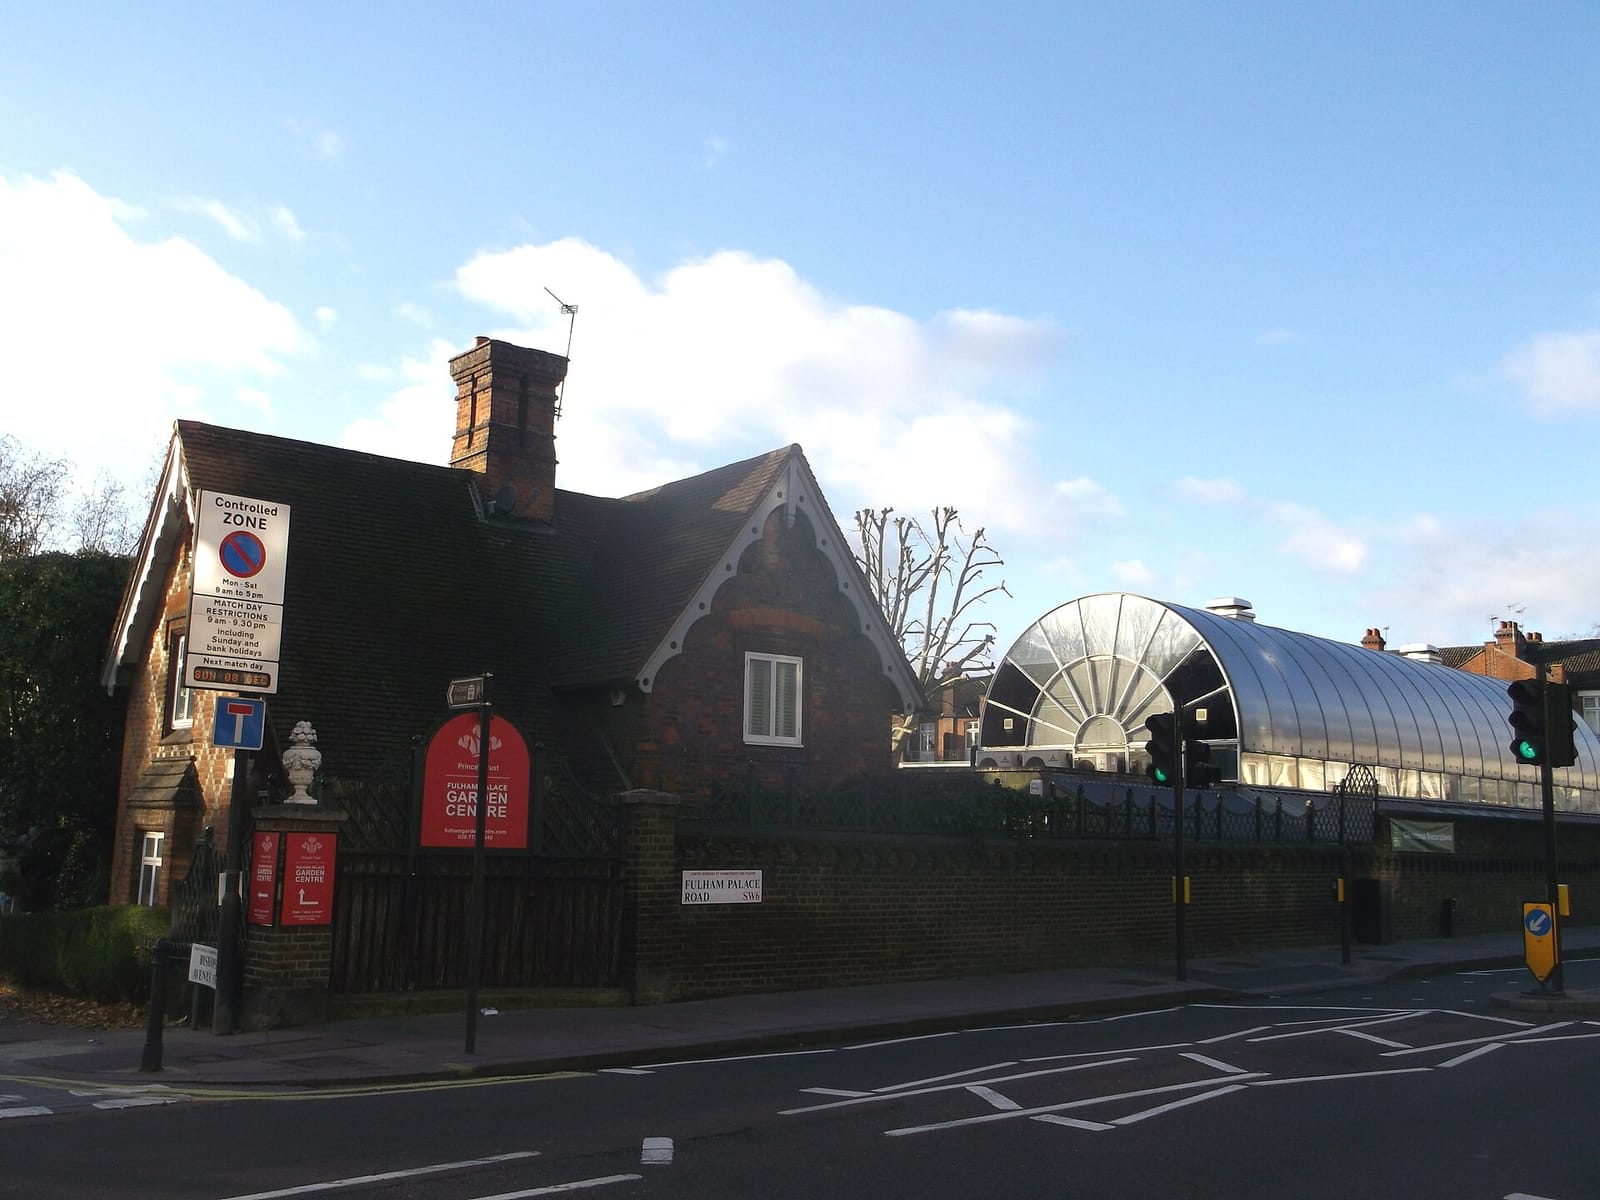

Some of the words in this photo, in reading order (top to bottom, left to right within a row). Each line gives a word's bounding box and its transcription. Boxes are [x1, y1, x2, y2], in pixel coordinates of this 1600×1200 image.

[215, 497, 278, 516] Controlled
[223, 512, 267, 530] ZONE
[235, 588, 243, 596] to
[214, 600, 243, 609] MATCH
[246, 603, 263, 611] DAY
[206, 607, 268, 621] RESTRICTIONS
[211, 636, 242, 646] Sunday
[244, 640, 259, 648] and
[206, 644, 227, 652] bank
[229, 646, 262, 657] holidays
[203, 657, 222, 665] Next
[224, 659, 248, 668] match
[250, 662, 264, 670] day
[194, 669, 217, 680] SUN
[224, 672, 239, 682] 08
[447, 782, 479, 790] FULHAM
[446, 790, 508, 804] GAREN
[445, 804, 507, 818] CENRE
[685, 879, 724, 889] FULHAM
[727, 879, 760, 889] PALACE
[684, 892, 710, 902] ROAD
[742, 891, 760, 901] SW6
